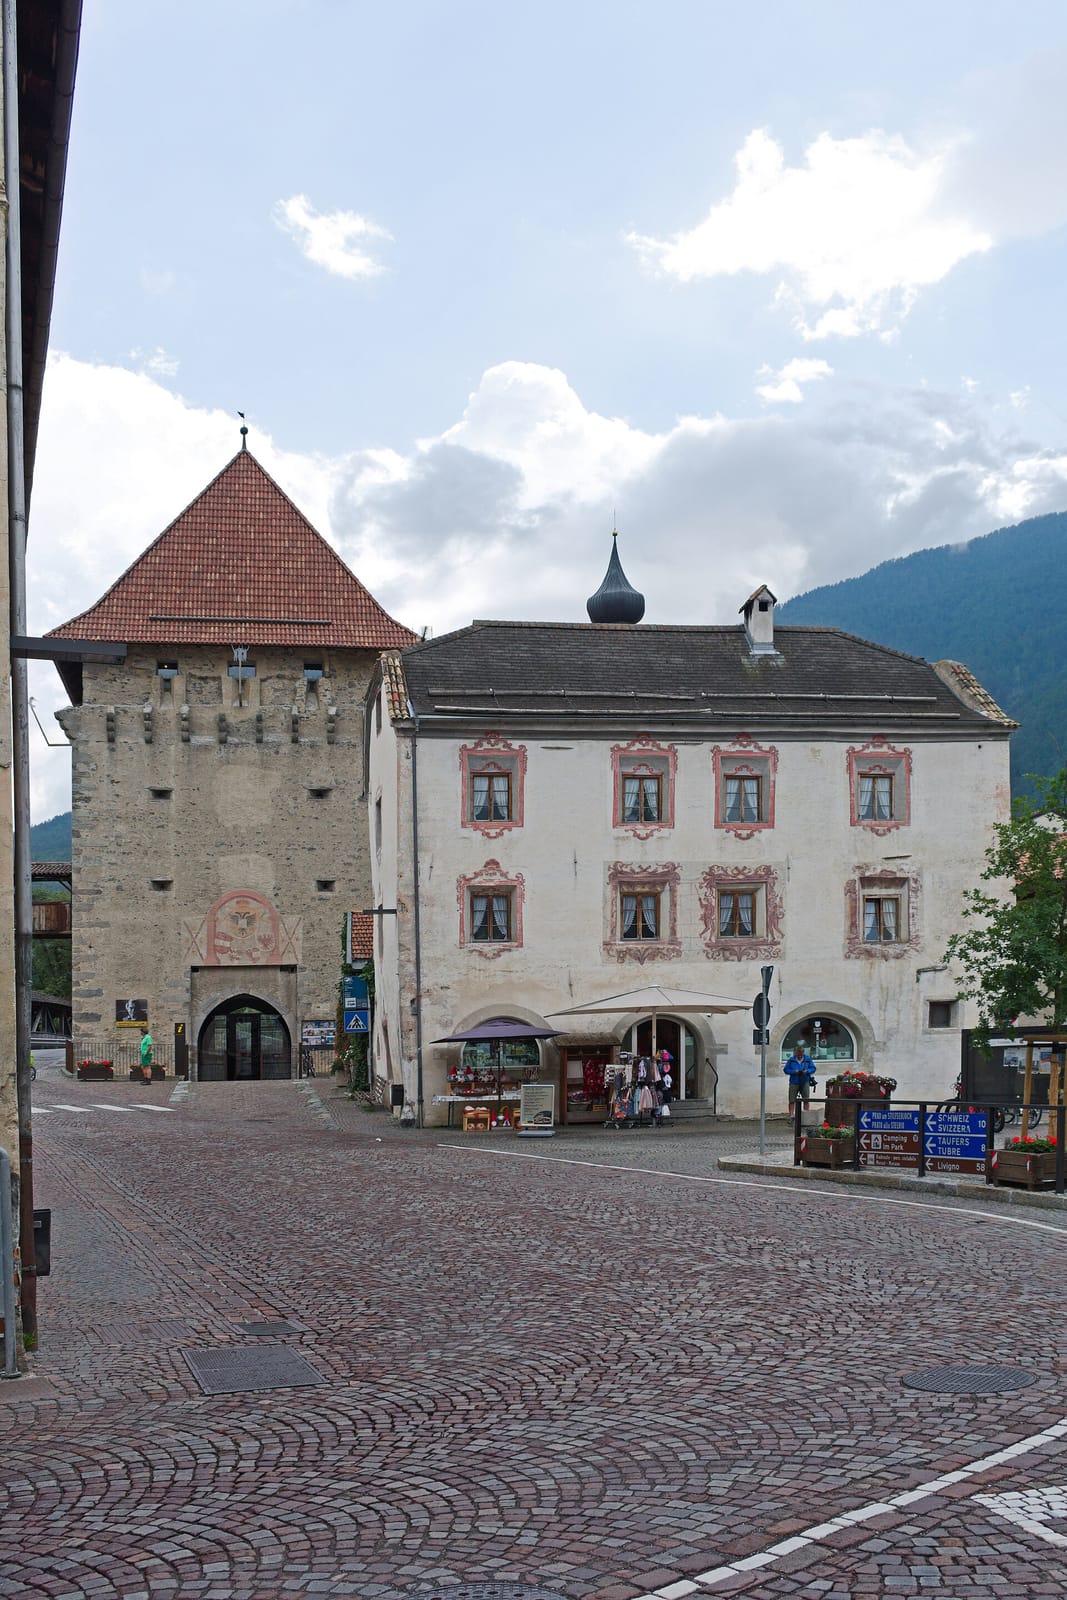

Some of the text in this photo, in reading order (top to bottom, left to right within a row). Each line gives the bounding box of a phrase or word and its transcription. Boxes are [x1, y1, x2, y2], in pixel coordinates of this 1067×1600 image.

[914, 1117, 919, 1125] 6
[938, 1114, 970, 1122] SCHWEIZ
[978, 1120, 986, 1128] 10
[882, 1134, 908, 1143] Camping
[938, 1137, 970, 1146] TAUFERS
[938, 1147, 960, 1156] TUBRE
[981, 1144, 986, 1152] 8
[938, 1162, 960, 1171] Livigno
[976, 1162, 986, 1172] 58
